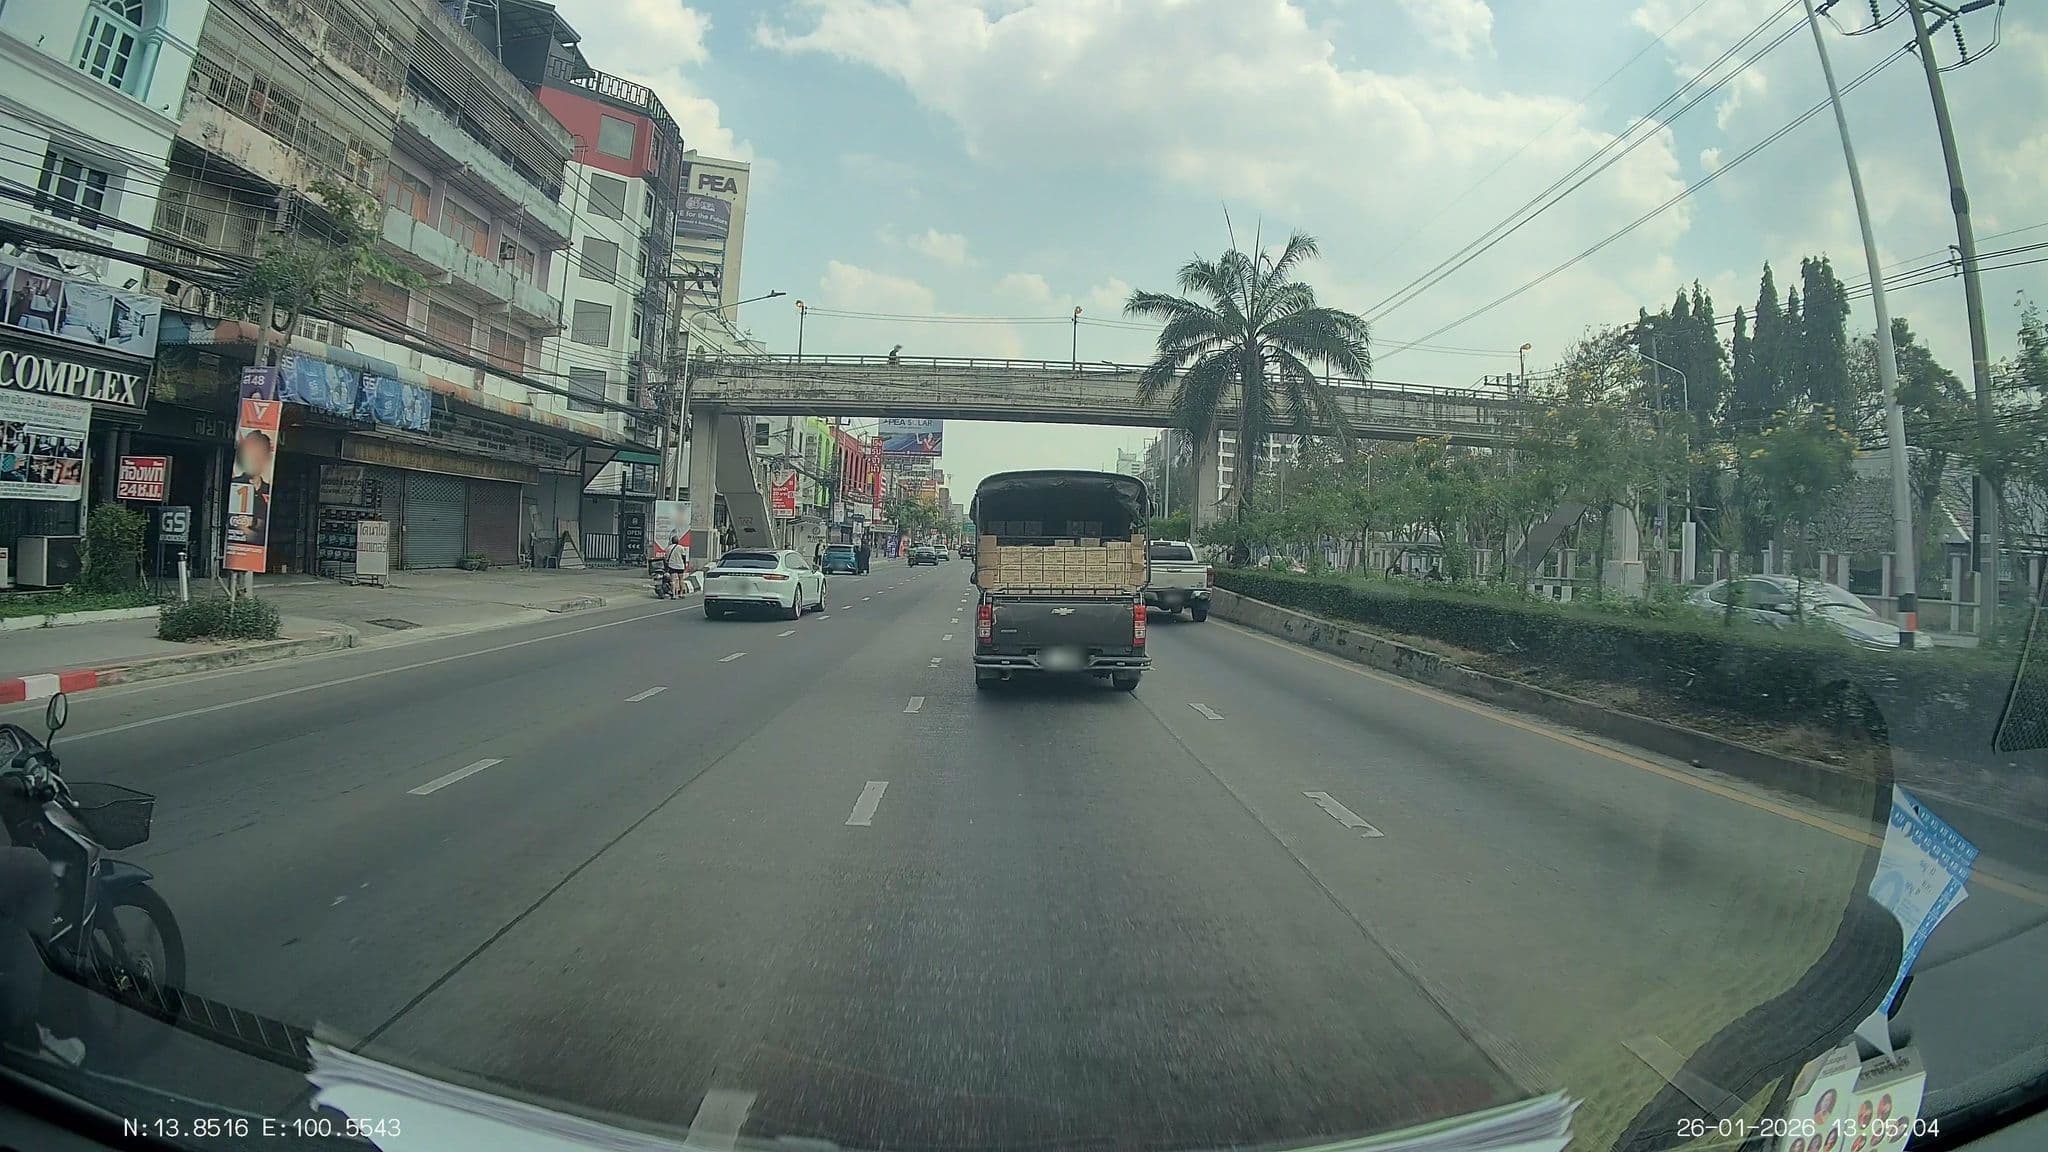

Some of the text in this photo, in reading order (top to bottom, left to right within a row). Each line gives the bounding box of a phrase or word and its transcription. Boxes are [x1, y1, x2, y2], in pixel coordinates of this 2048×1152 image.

[698, 173, 738, 194] PEA
[698, 212, 709, 220] the
[0, 350, 142, 406] COMPLEX
[888, 418, 906, 426] PEA
[237, 486, 248, 512] 1
[161, 511, 186, 533] GS
